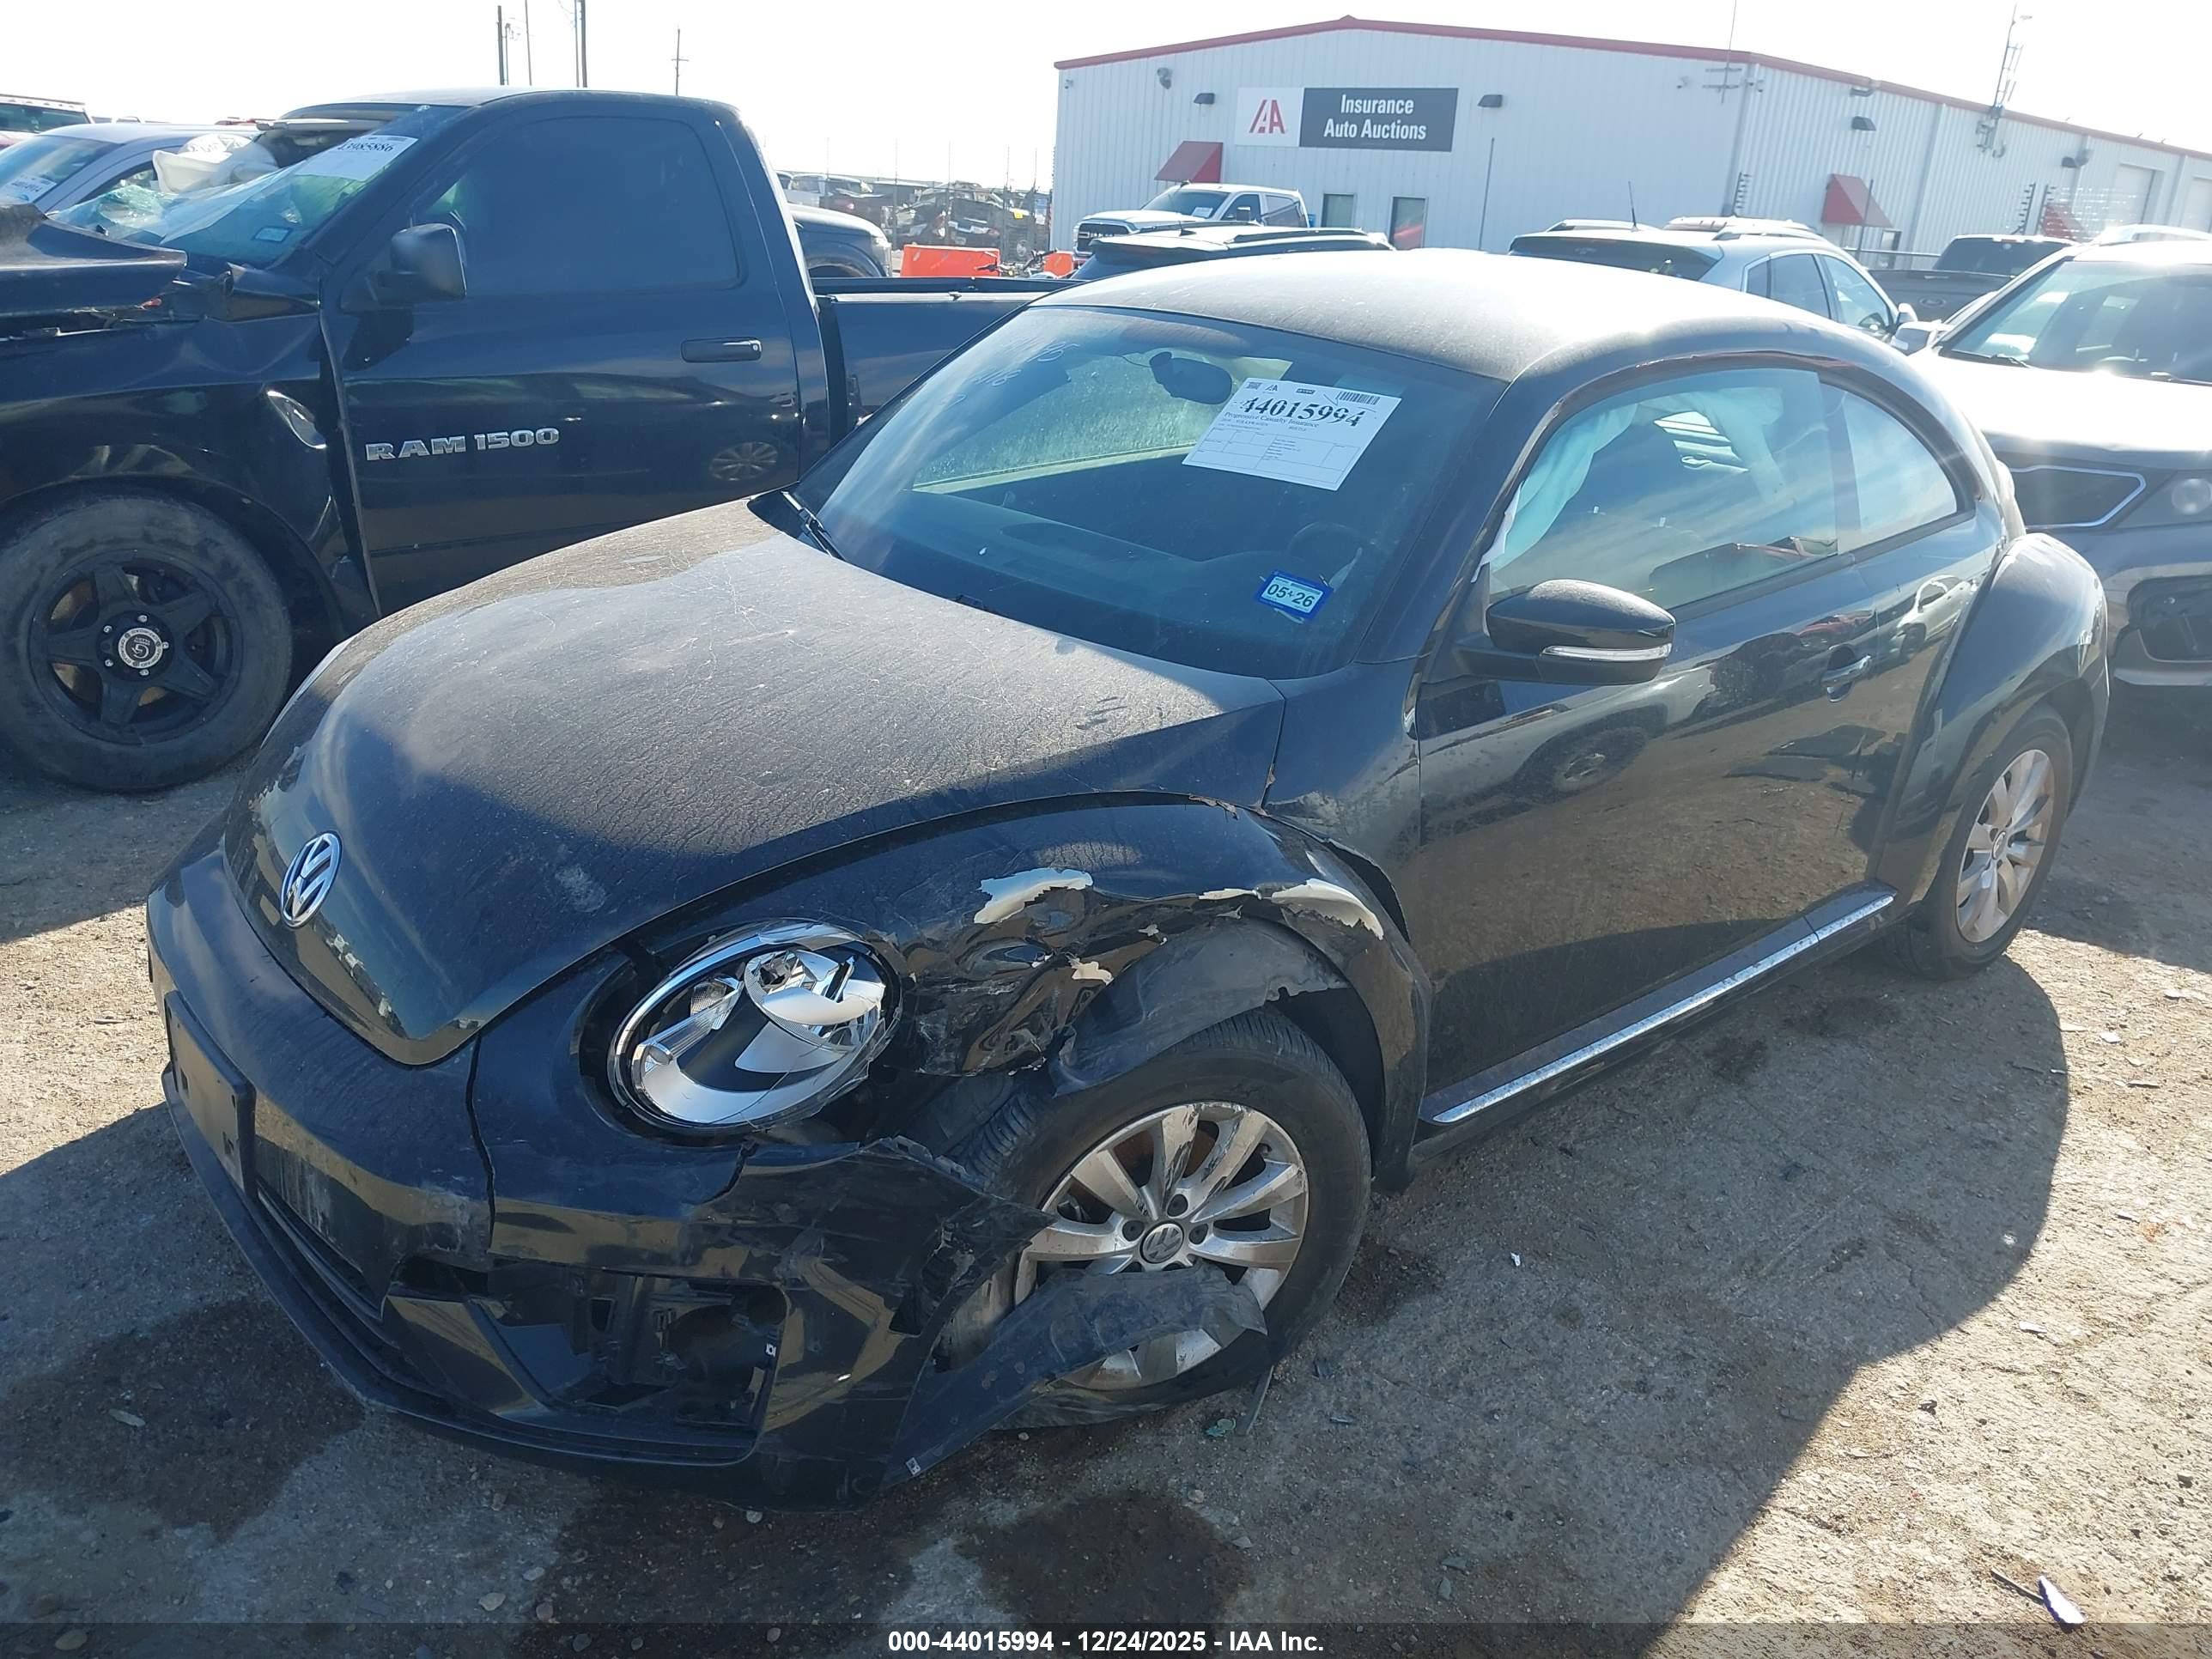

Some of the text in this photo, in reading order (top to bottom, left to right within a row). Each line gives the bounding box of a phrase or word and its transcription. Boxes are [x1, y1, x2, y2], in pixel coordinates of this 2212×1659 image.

[1340, 94, 1414, 114] Insurance
[1323, 118, 1427, 140] Auto Auctions
[1239, 397, 1366, 427] 44015994
[365, 428, 560, 461] RAM 1500
